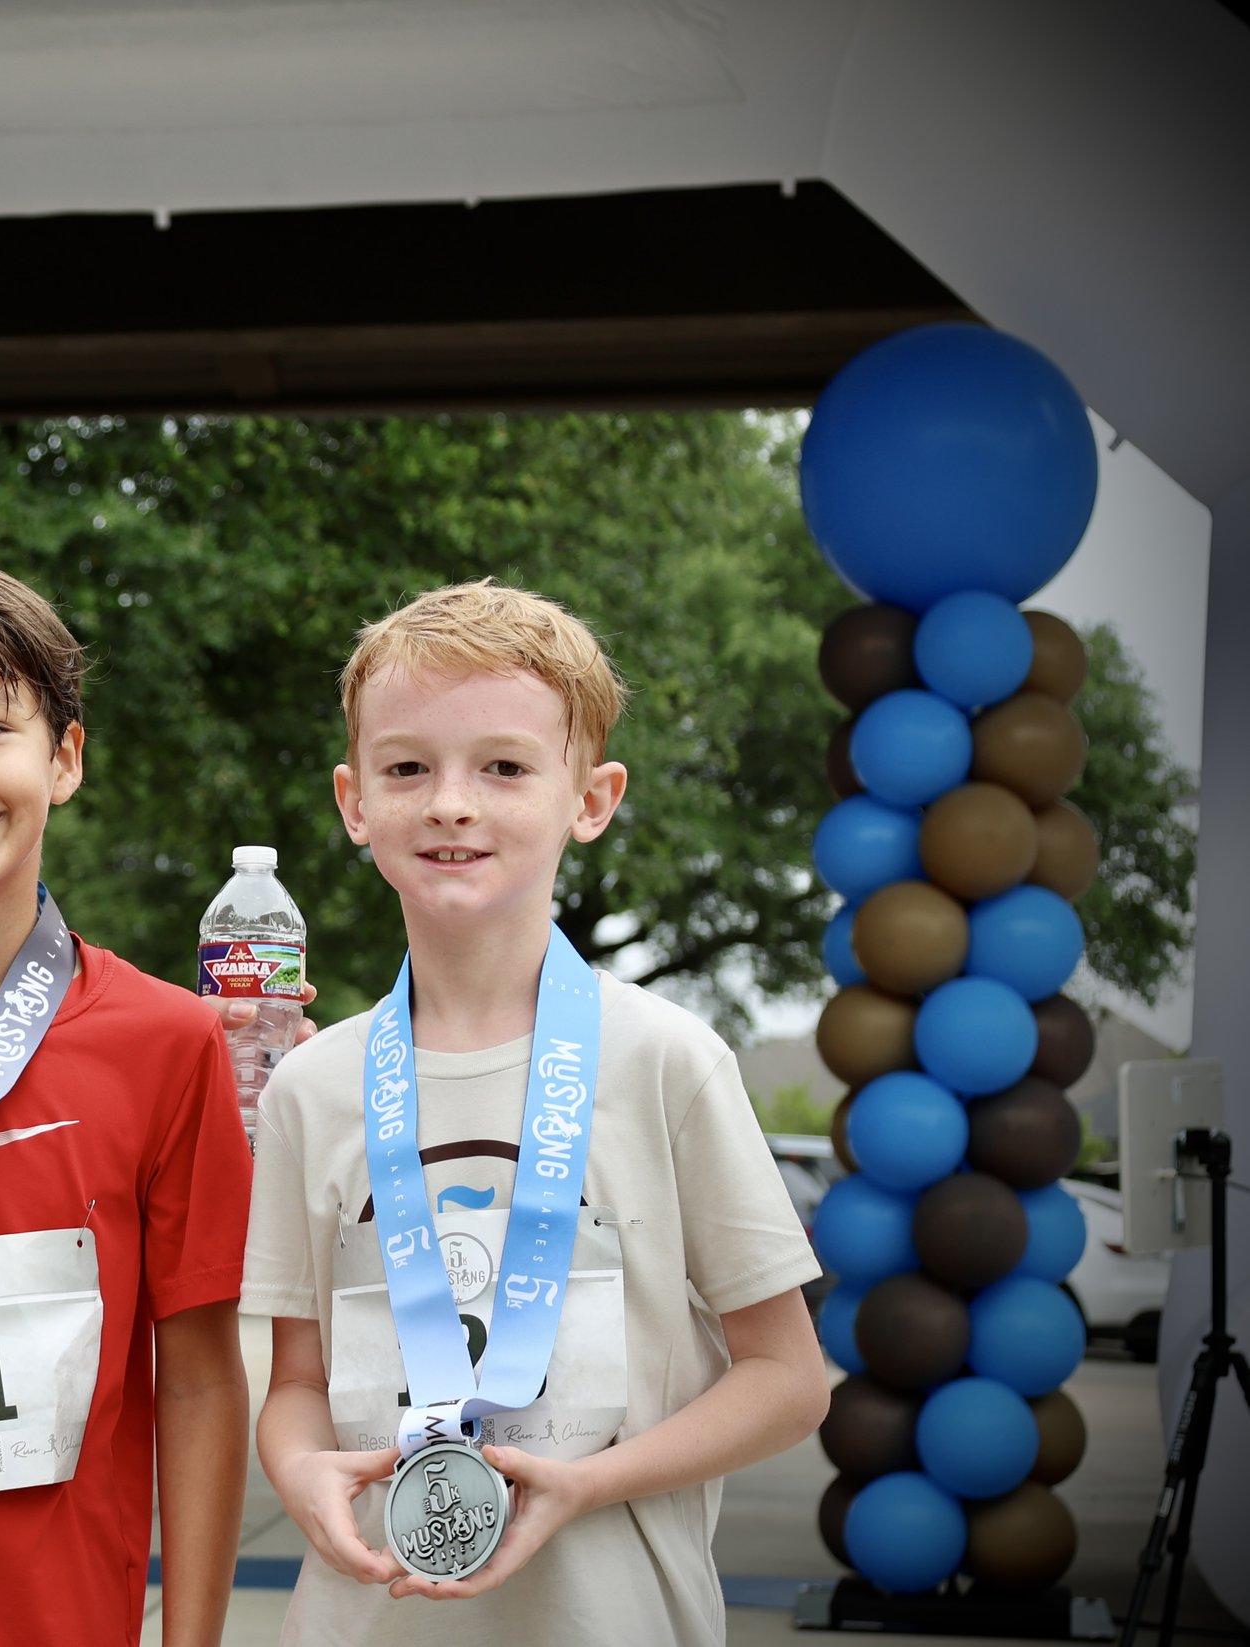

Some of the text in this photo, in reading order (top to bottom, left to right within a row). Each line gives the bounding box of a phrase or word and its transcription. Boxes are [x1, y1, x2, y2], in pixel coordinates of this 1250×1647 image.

[212, 961, 271, 976] OZARKA
[370, 1006, 410, 1141] MUSTANG
[532, 1038, 587, 1180] MUSTANG
[387, 1148, 406, 1218] LAKES
[532, 1191, 556, 1263] LAKES
[358, 1432, 397, 1451] Resu
[504, 1424, 537, 1442] Run
[401, 1503, 495, 1559] MUSTANG
[430, 1540, 476, 1565] LAKES
